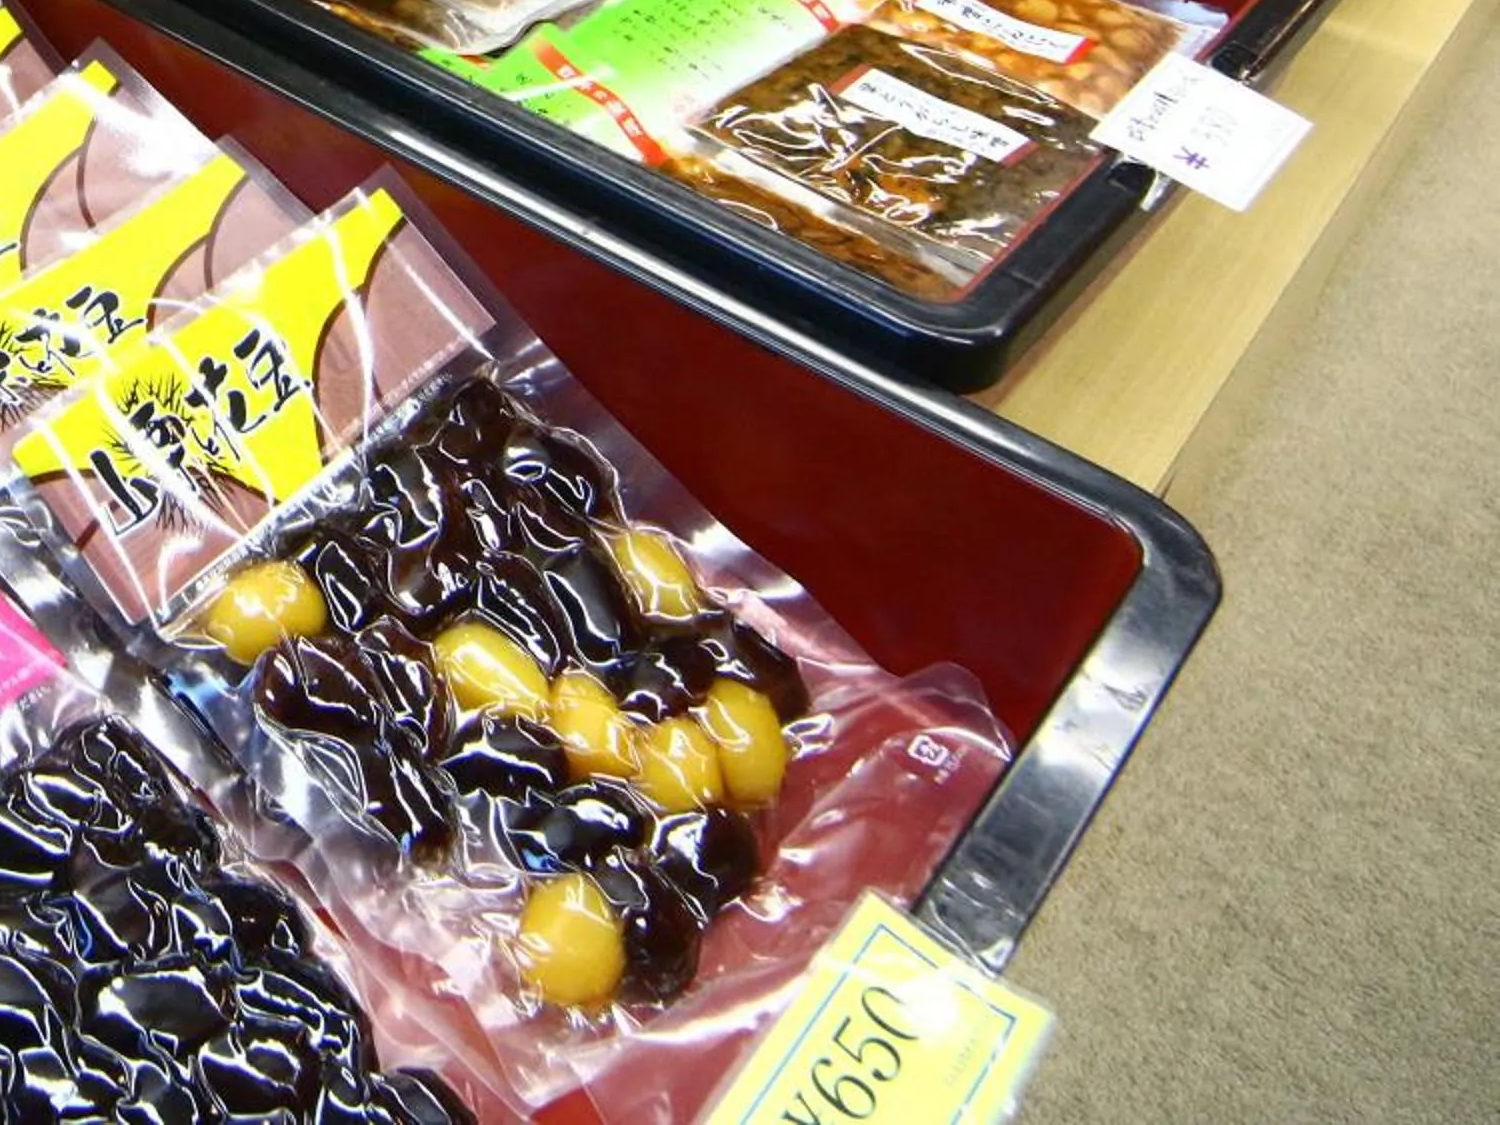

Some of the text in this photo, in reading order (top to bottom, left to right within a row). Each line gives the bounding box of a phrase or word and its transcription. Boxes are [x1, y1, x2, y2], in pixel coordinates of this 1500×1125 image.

[86, 329, 311, 540] 山栗と花豆
